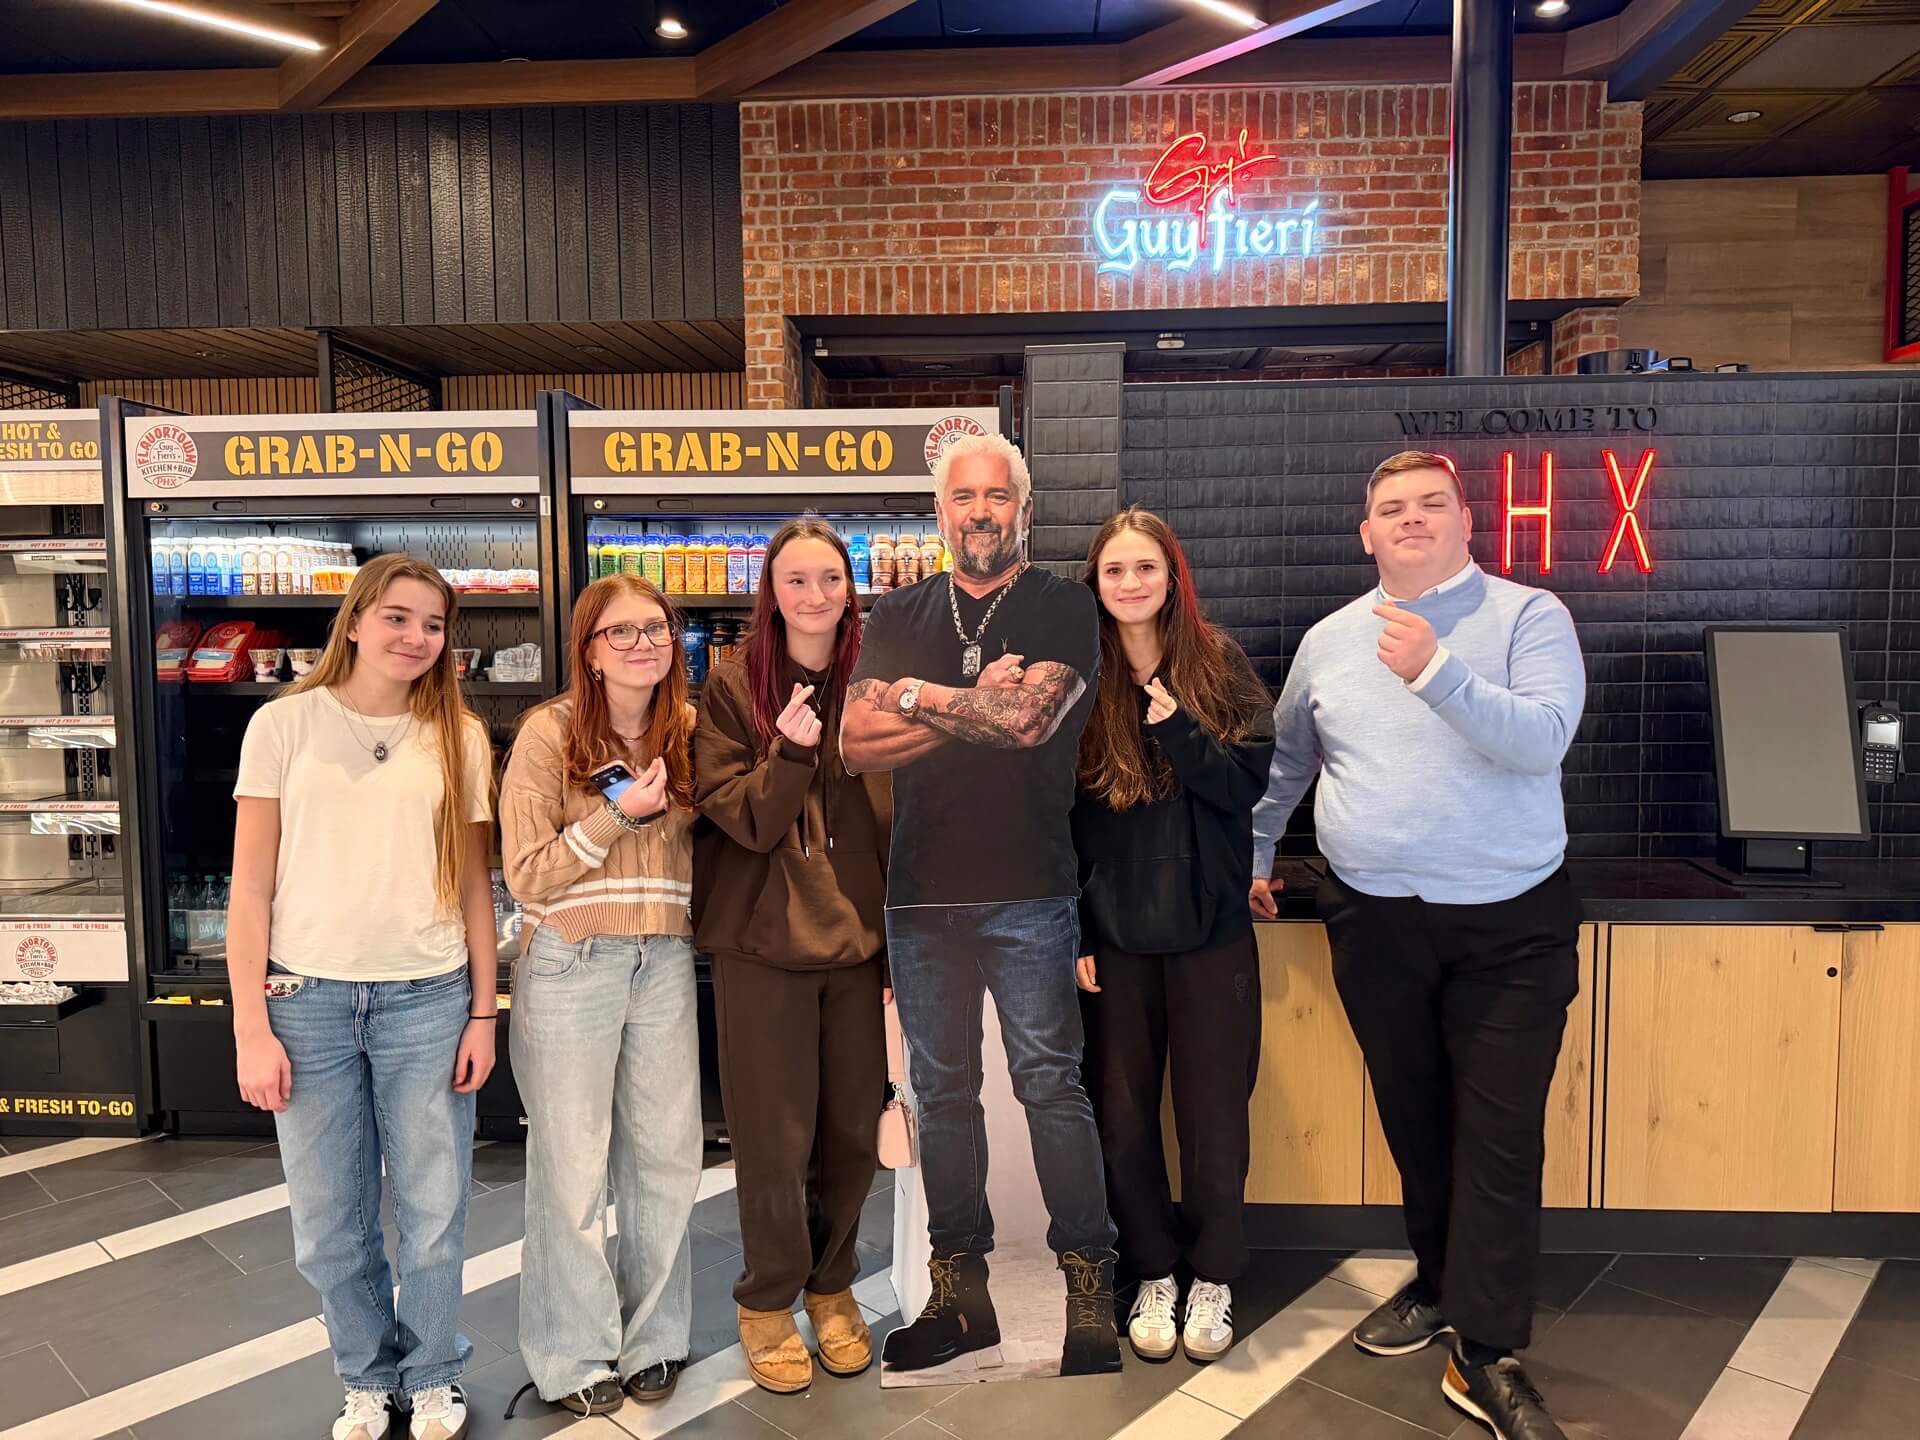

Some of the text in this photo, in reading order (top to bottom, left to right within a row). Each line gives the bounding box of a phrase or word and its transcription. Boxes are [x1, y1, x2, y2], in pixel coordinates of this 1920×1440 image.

[2, 422, 62, 440] HOT &
[1394, 407, 1658, 435] WELCOME TO
[158, 442, 174, 453] Guy
[926, 418, 986, 458] FLAVORTO
[0, 441, 98, 460] ESH TO GO
[224, 431, 503, 476] GRAB-N-GO
[604, 430, 893, 473] GRAB-N-GO
[156, 477, 177, 486] PHX
[1500, 448, 1656, 576] HX
[0, 1097, 134, 1116] & FRESH TO-GO
